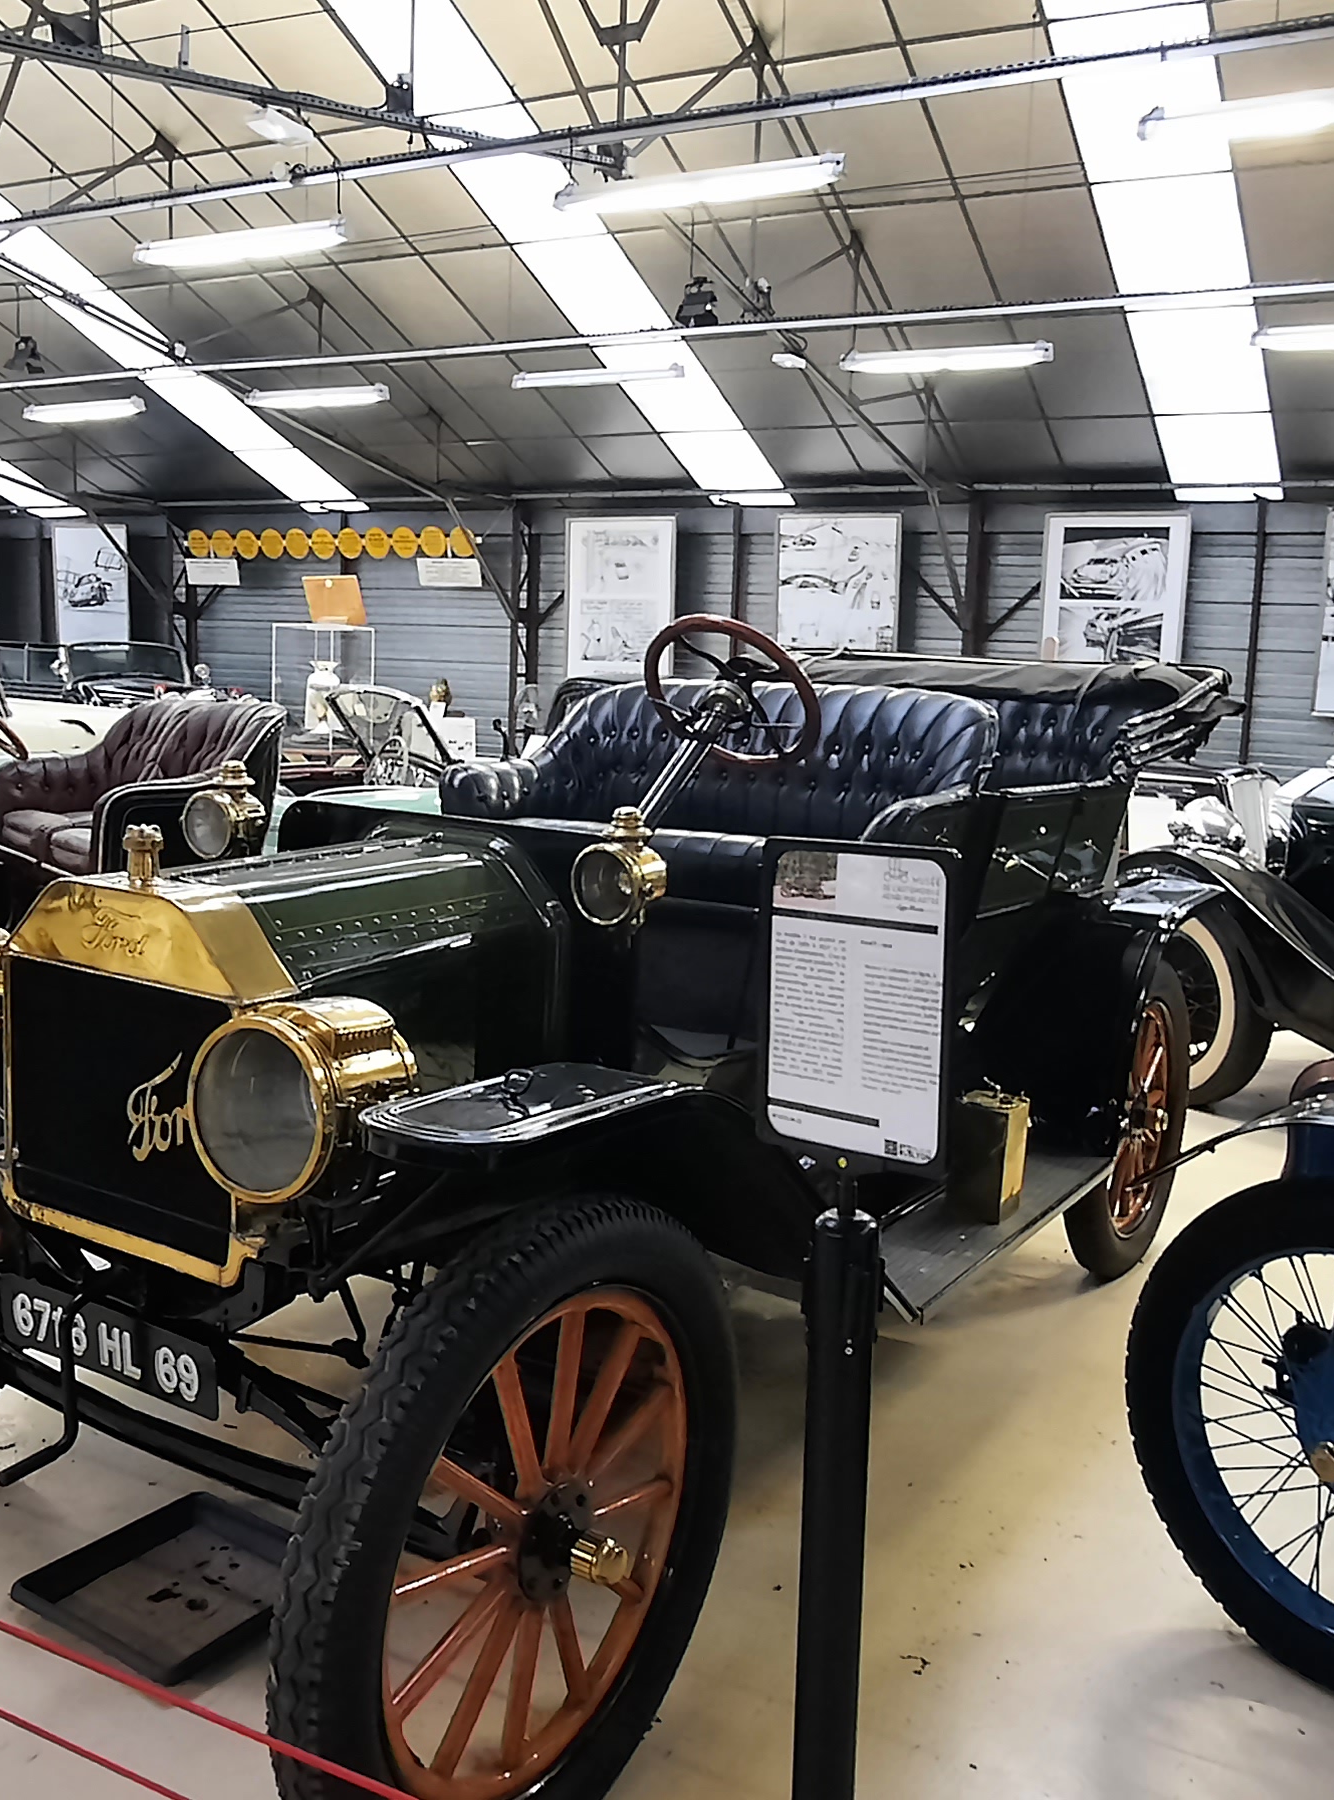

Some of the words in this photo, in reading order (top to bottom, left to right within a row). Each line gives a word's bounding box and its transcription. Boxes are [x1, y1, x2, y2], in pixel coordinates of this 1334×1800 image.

[81, 905, 149, 957] Ford
[126, 1051, 190, 1163] For
[98, 1322, 142, 1380] HL
[155, 1346, 200, 1402] 69
